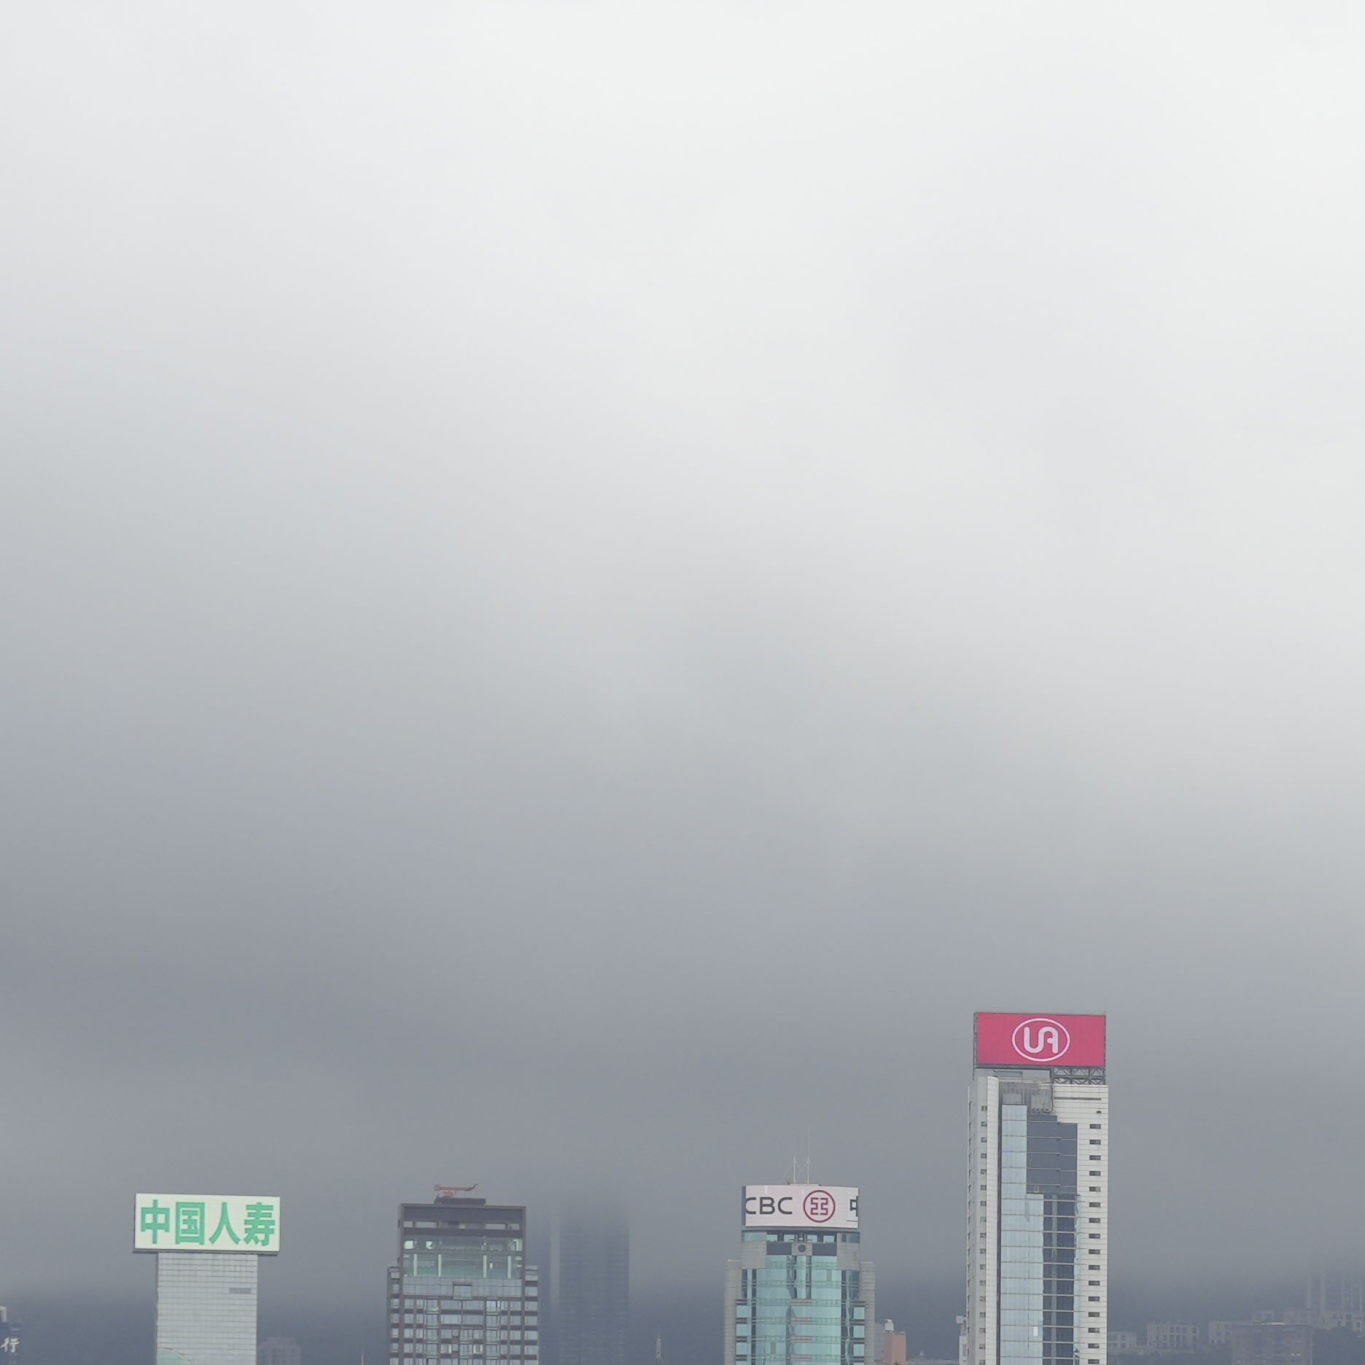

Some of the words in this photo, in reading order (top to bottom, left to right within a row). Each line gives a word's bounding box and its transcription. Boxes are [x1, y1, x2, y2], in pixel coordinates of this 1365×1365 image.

[745, 1197, 793, 1215] CBC
[140, 1199, 276, 1247] 中国人寿
